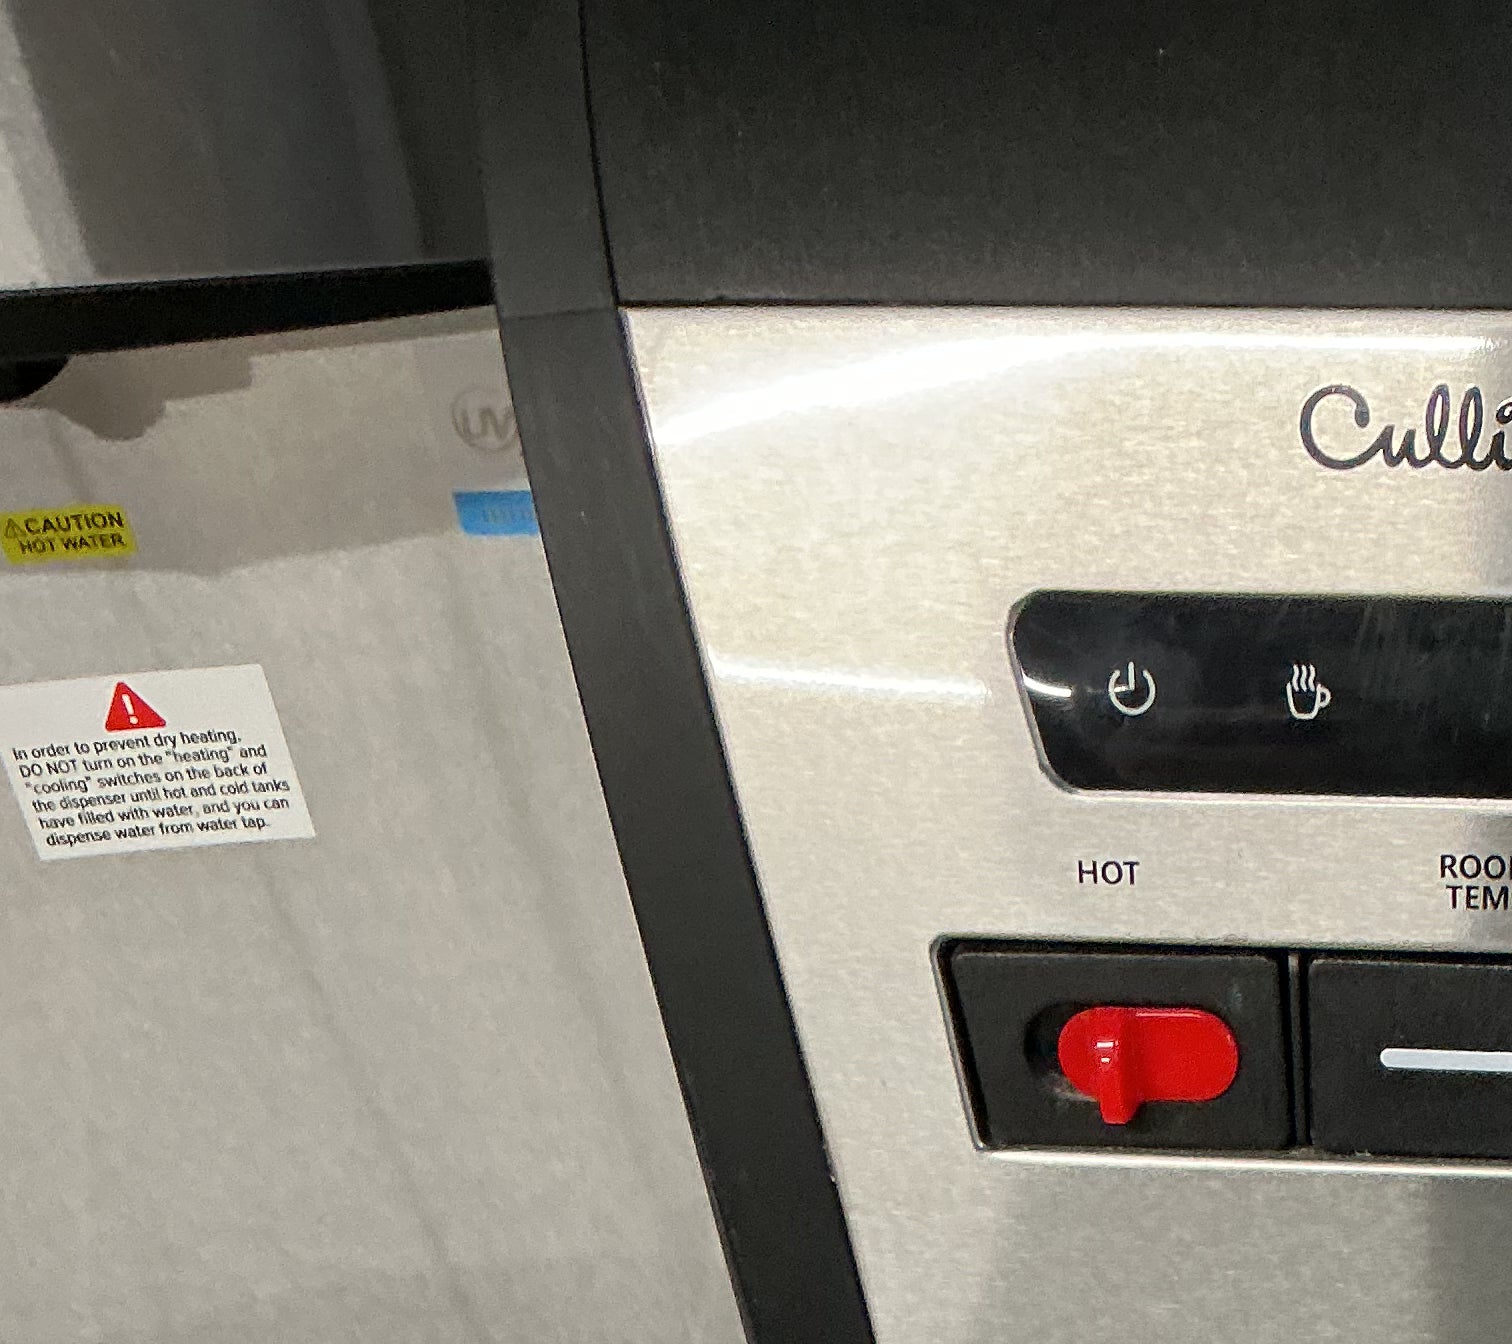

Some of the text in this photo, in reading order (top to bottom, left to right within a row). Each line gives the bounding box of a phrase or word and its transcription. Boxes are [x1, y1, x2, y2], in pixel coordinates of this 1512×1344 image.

[24, 511, 124, 535] CAUTION
[19, 532, 126, 555] HOT WATER
[12, 746, 28, 761] In
[31, 743, 71, 759] order
[73, 740, 91, 756] to
[93, 735, 150, 756] prevent
[153, 732, 177, 749] dry
[19, 763, 43, 778] DO
[45, 759, 77, 776] NOT
[82, 758, 113, 772] turn
[116, 756, 136, 769] on
[137, 751, 163, 767] the
[239, 744, 267, 759] and
[97, 771, 162, 788] switches
[164, 770, 184, 783] on
[186, 766, 211, 780] the
[213, 763, 249, 778] back
[252, 761, 268, 776] of
[31, 779, 290, 813] the dispenser until hot and cold tanks
[38, 814, 75, 830] have
[77, 808, 115, 826] filled
[117, 805, 150, 822] with
[202, 799, 231, 815] and
[232, 801, 261, 816] you
[263, 797, 291, 810] can
[45, 829, 112, 848] dispense
[114, 824, 156, 840] water
[158, 819, 195, 836] from
[196, 818, 238, 833] water
[1077, 859, 1140, 887] HOT
